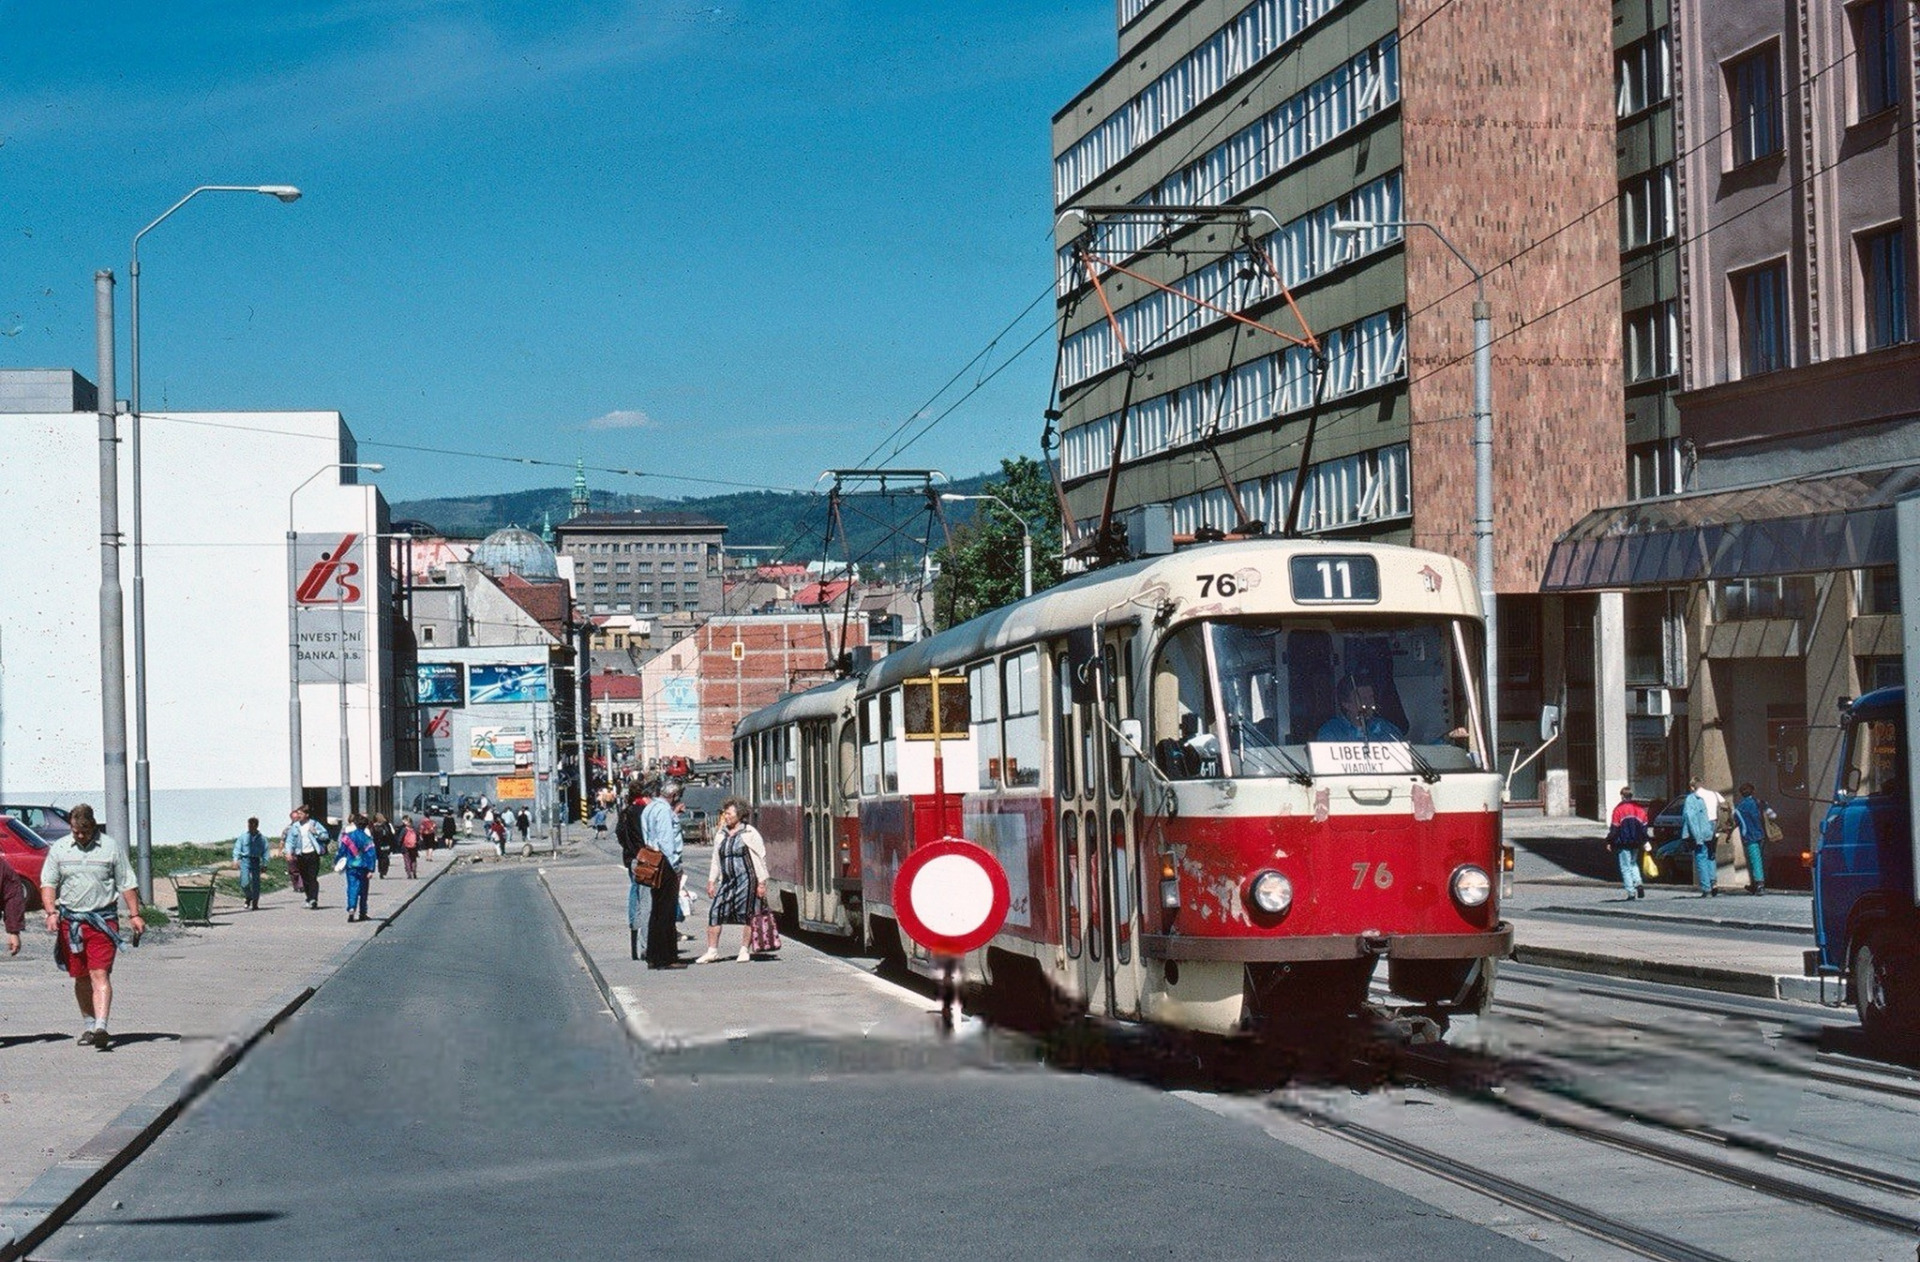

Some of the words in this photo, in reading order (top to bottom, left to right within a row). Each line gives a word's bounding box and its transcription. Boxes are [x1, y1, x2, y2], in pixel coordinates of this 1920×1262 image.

[1196, 573, 1236, 598] 76
[1317, 560, 1352, 598] 11
[297, 630, 361, 642] INVESTČNÍ
[1330, 746, 1390, 761] LIBEREC
[1341, 763, 1384, 773] VIADUKT
[1352, 862, 1393, 889] 76
